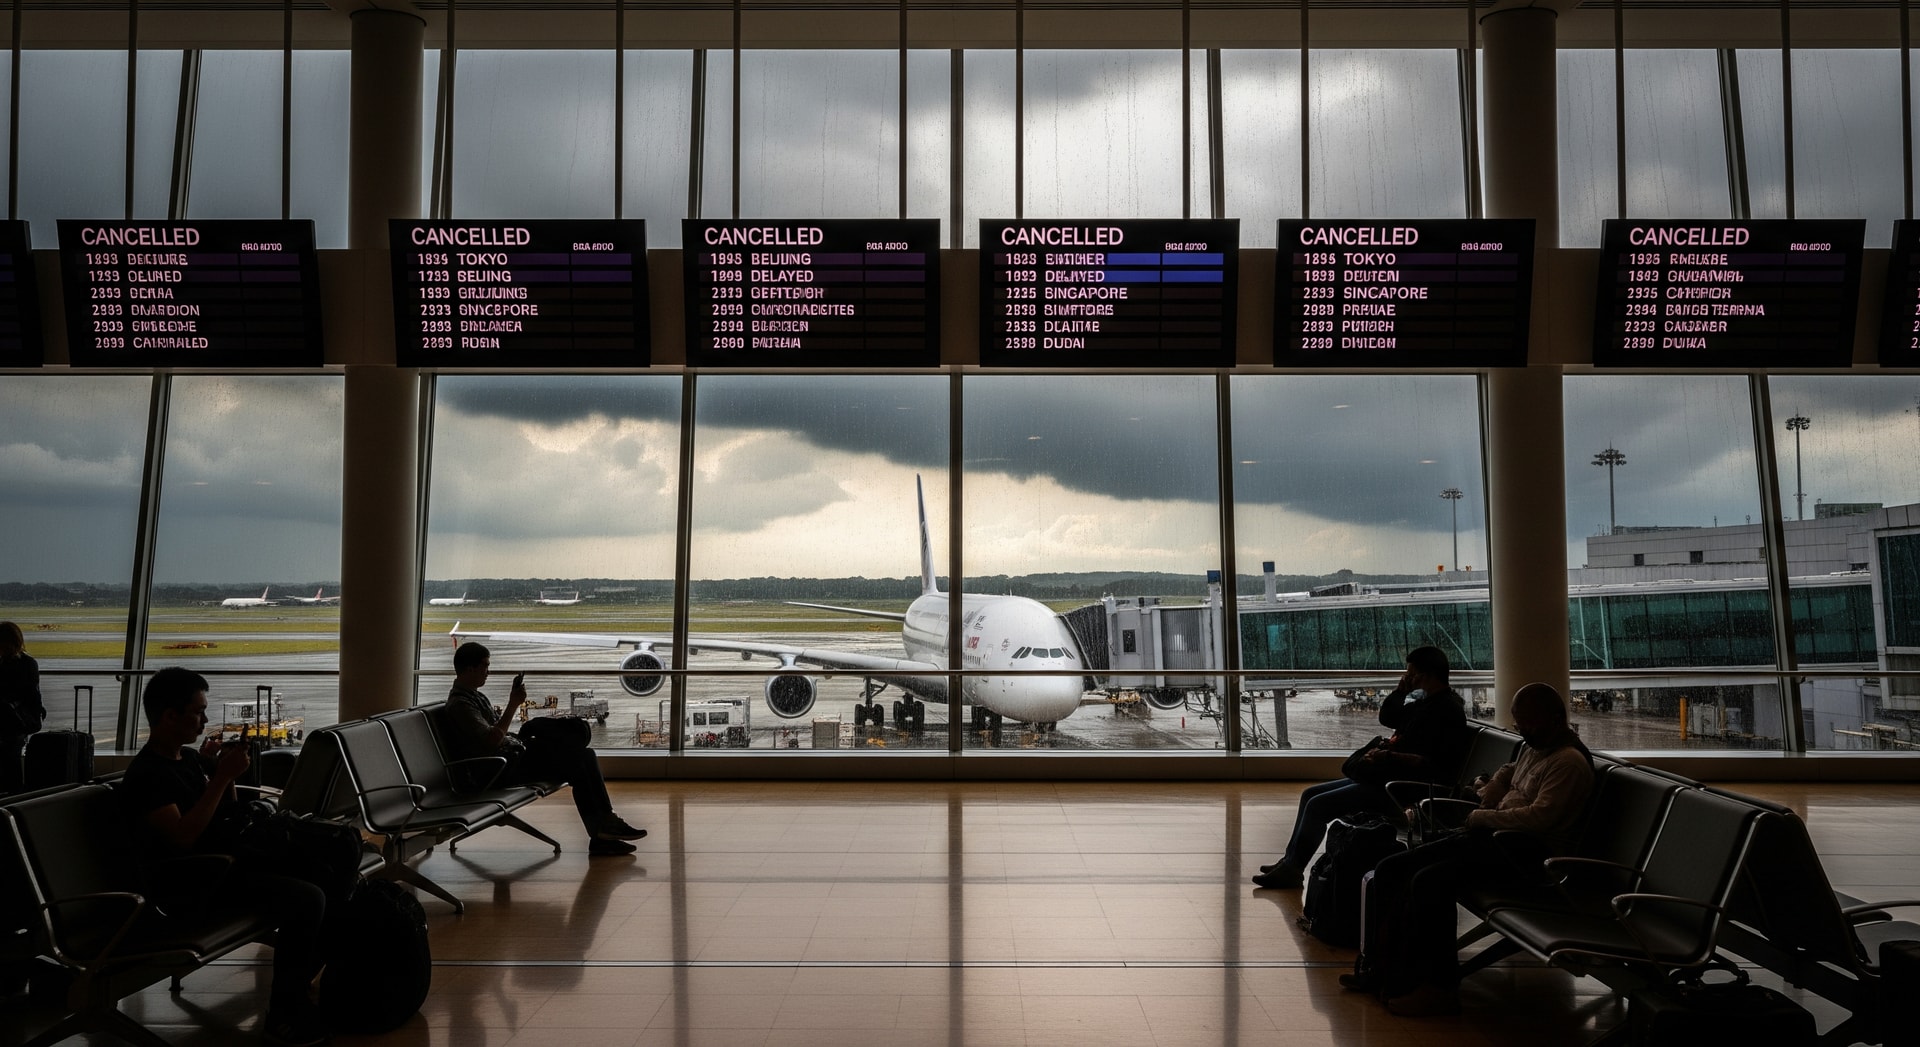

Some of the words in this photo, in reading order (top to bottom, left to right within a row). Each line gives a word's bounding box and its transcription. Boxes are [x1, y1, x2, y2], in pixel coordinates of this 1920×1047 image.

[81, 227, 200, 246] CANCELLED
[411, 227, 531, 246] CANCELLED
[704, 226, 824, 246] CANCELLED
[1001, 226, 1124, 246] CANCELLED
[1299, 226, 1419, 246] CANCELLED
[1629, 227, 1750, 246] CANCELLED
[455, 253, 508, 265] TOKYO
[1343, 253, 1396, 265] TOKYO
[750, 270, 814, 282] DELAYED
